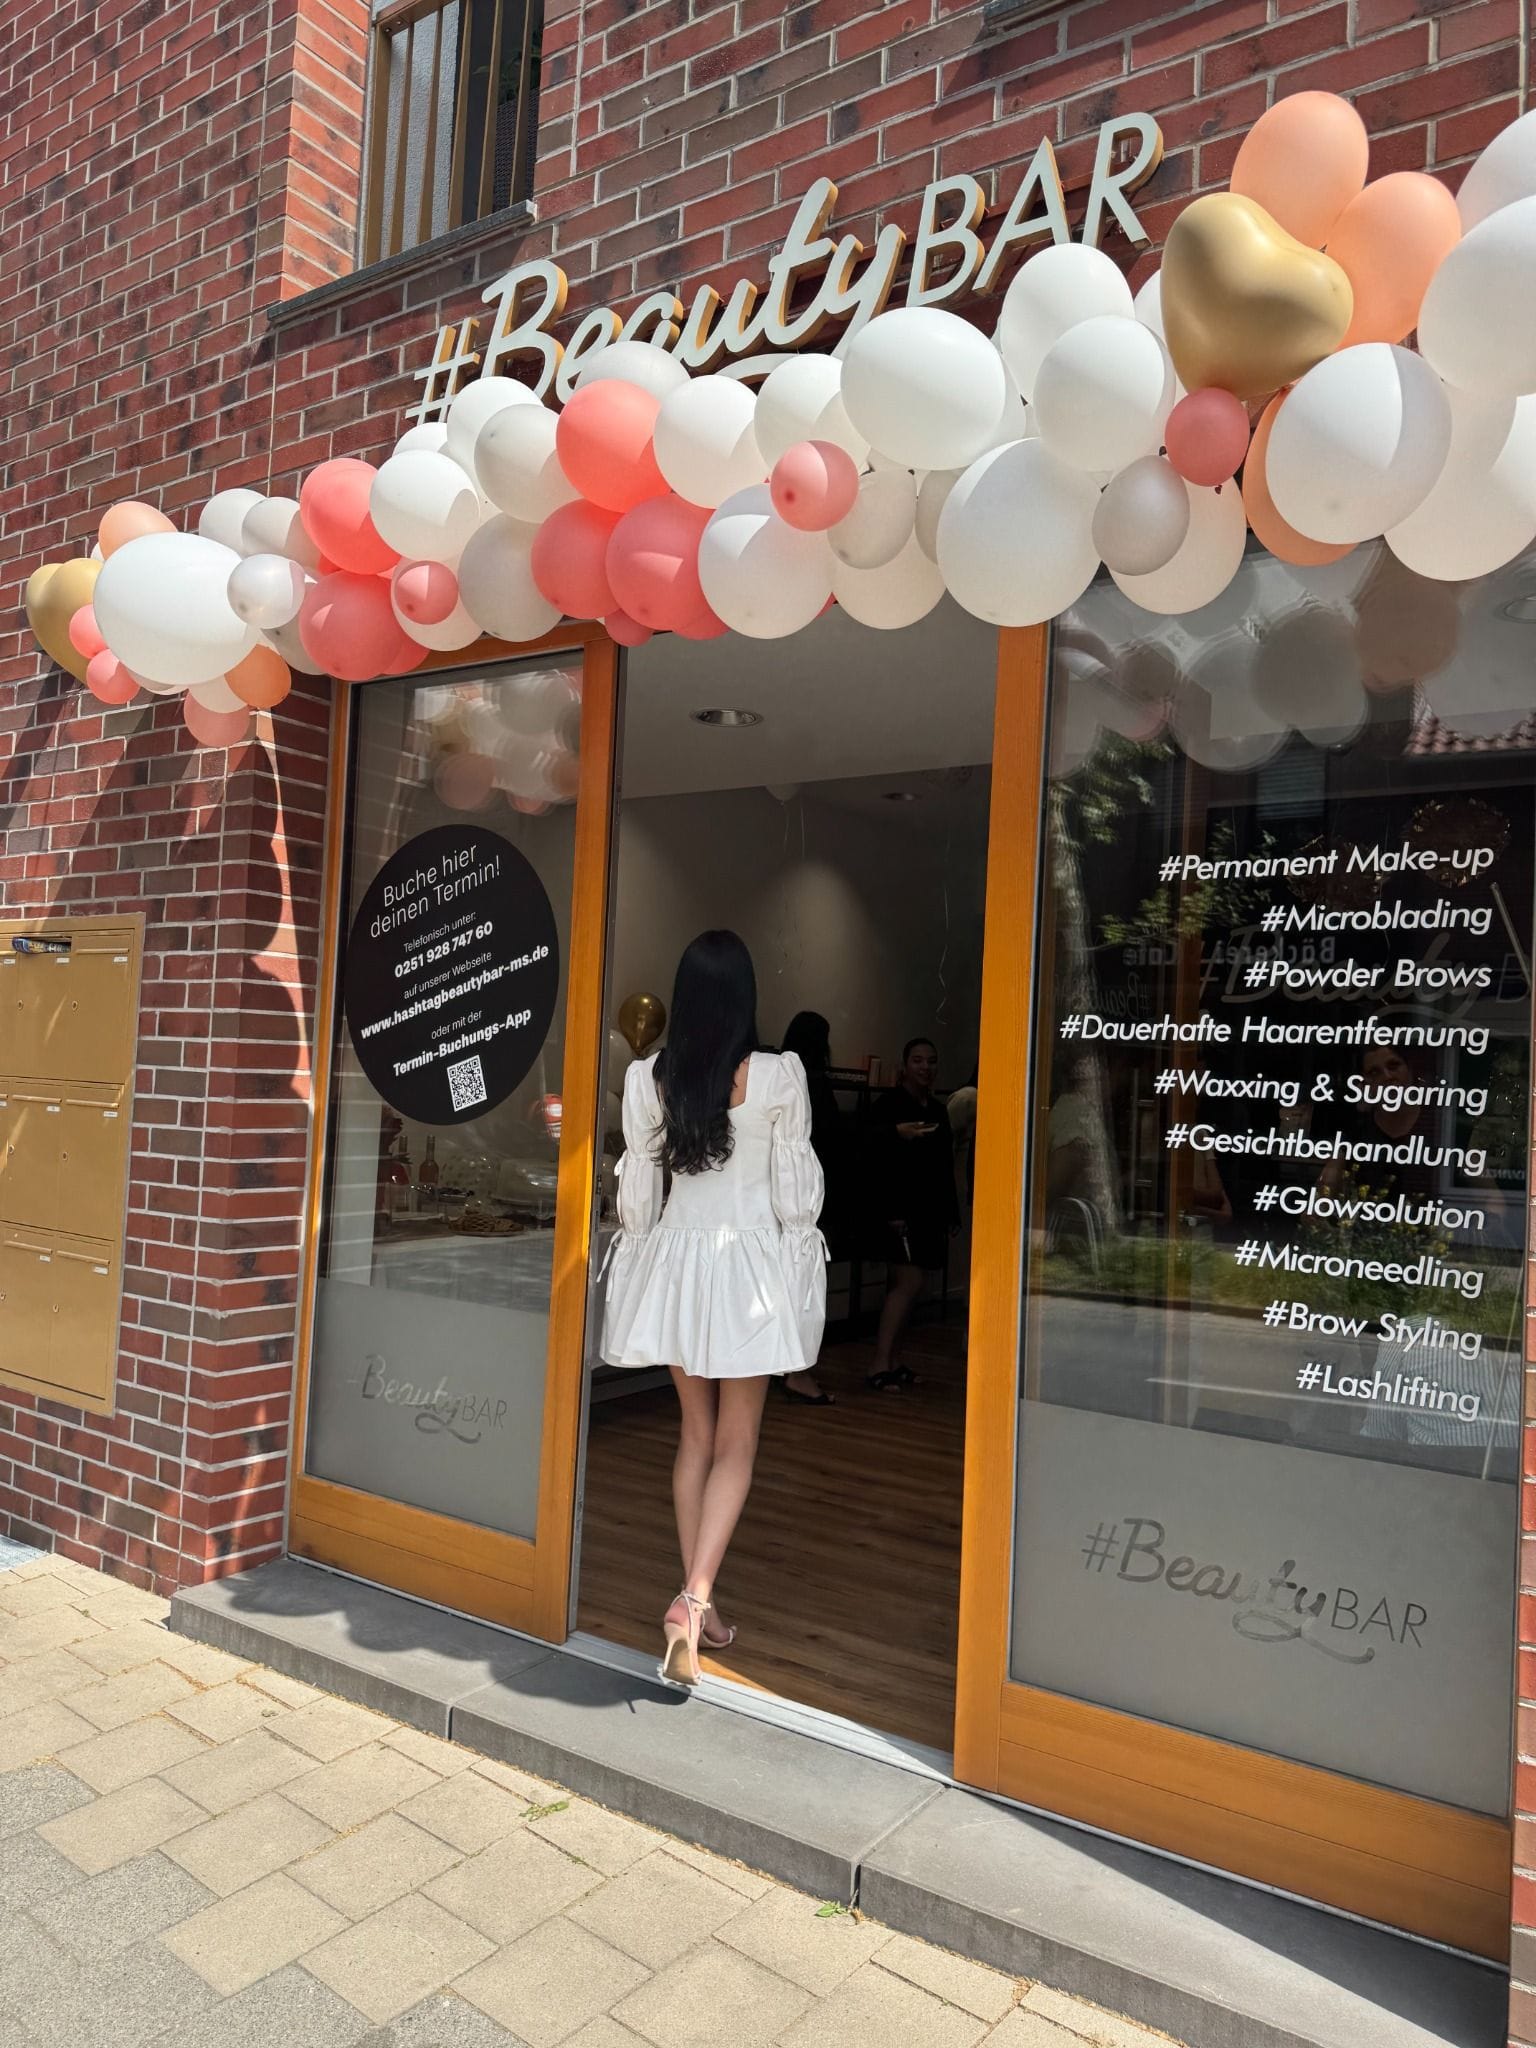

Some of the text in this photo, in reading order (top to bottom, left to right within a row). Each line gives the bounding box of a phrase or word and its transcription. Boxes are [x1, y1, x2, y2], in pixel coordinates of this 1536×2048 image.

[383, 844, 477, 908] Buche hier
[1158, 842, 1494, 882] #Permanent Make-up
[370, 854, 501, 938] deinen Termin!
[1260, 898, 1493, 935] #Microblading
[394, 920, 493, 978] 0251 928 747 60
[403, 911, 477, 953] Telefonisch unter:
[360, 945, 549, 1040] www.hashtagbeautybar-ms.de
[403, 951, 492, 1000] auf unserer Webseite
[1243, 959, 1493, 988] #Powder Brows
[393, 1008, 532, 1077] Termin-Buchungs-App
[431, 1009, 483, 1040] oder mit der
[1059, 1013, 1490, 1055] #Dauerhafte Haarentfernung
[1153, 1068, 1488, 1116] #Waxxing & Sugaring
[1164, 1123, 1487, 1177] #Gesichtbehandlung
[1253, 1184, 1485, 1230] #Glowsolution
[1234, 1239, 1484, 1299] #Microneedling
[1263, 1299, 1483, 1361] #Brow Styling
[1295, 1362, 1481, 1422] #Lashlifting
